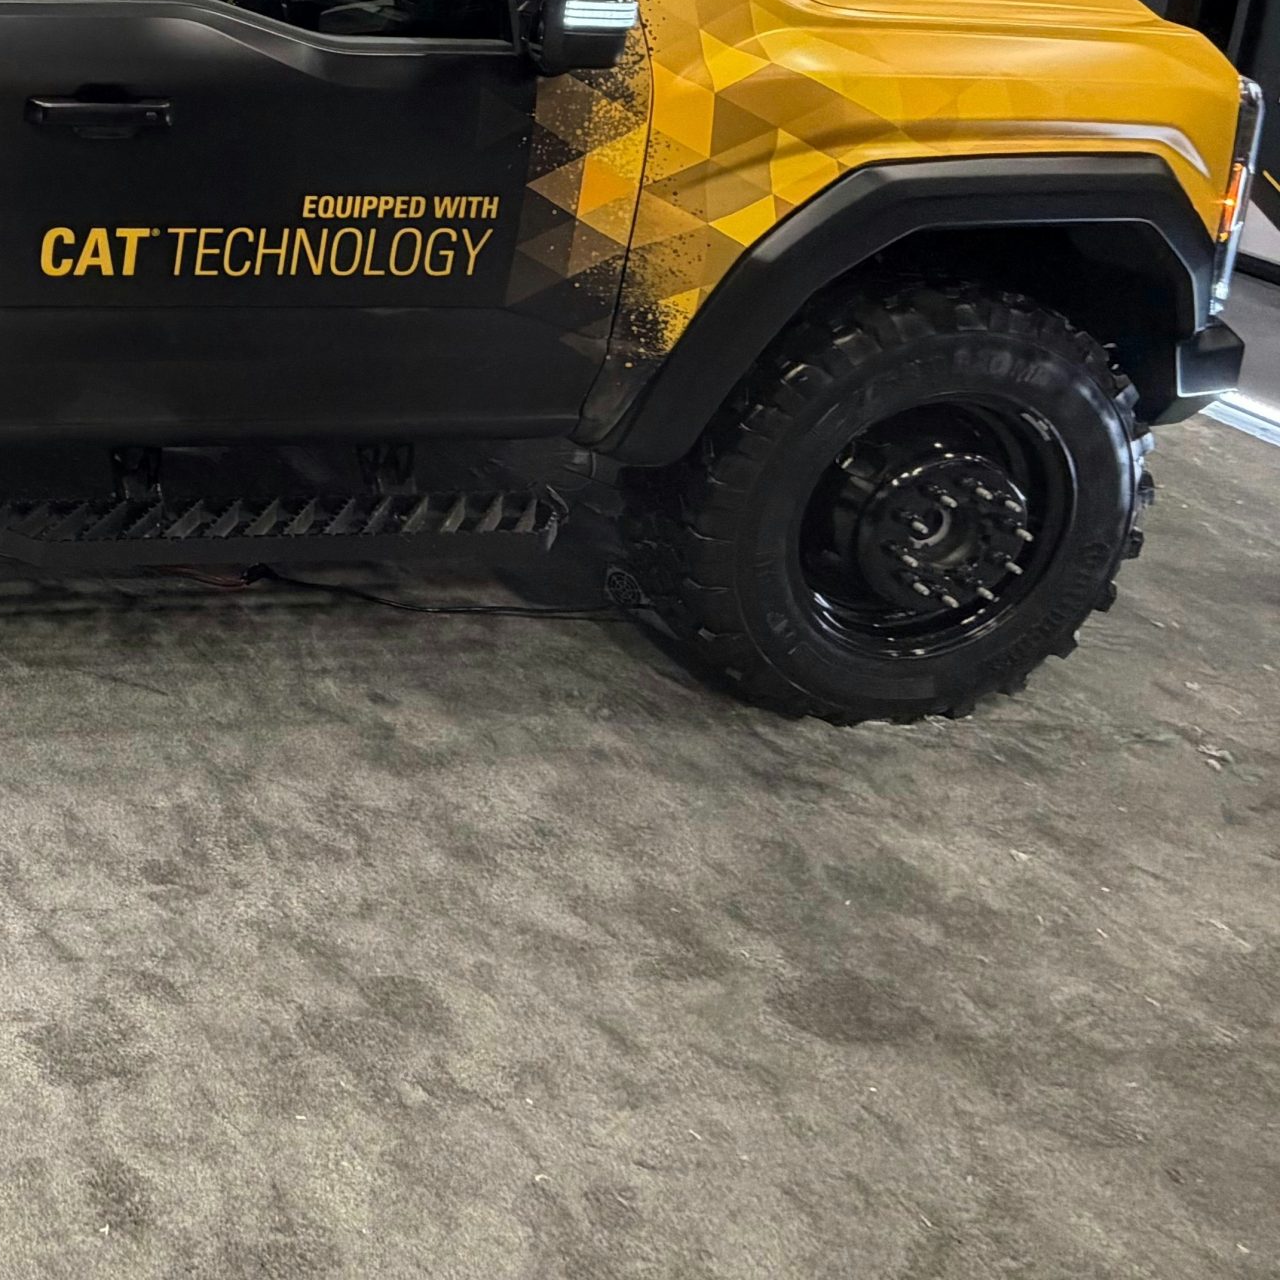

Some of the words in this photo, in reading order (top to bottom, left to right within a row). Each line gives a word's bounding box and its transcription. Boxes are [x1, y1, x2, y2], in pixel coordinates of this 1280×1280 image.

[302, 195, 426, 220] EQUIPPED
[432, 196, 500, 219] WITH
[167, 227, 494, 276] TECHNOLOGY
